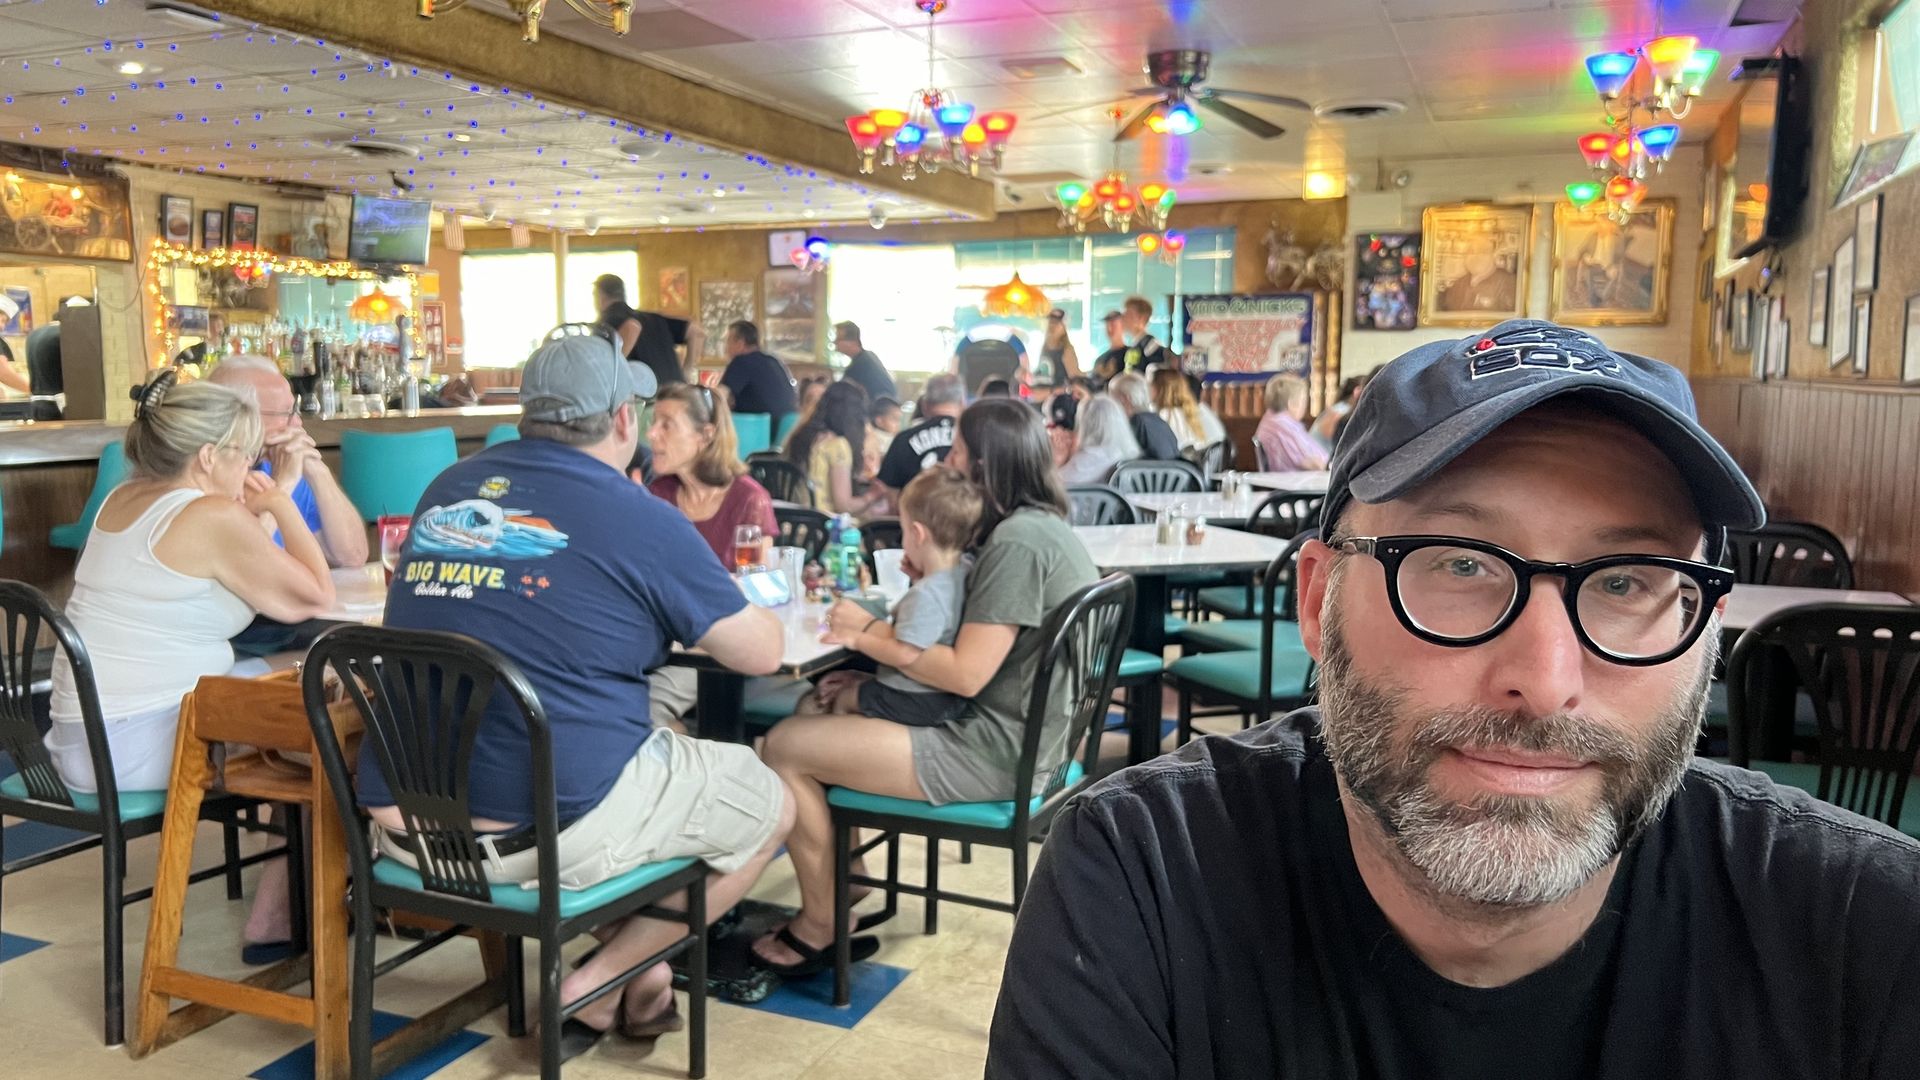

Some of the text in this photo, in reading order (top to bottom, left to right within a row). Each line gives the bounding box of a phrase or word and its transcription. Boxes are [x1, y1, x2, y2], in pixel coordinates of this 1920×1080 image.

[404, 561, 435, 583] BIG
[415, 581, 474, 600] Golden Ale
